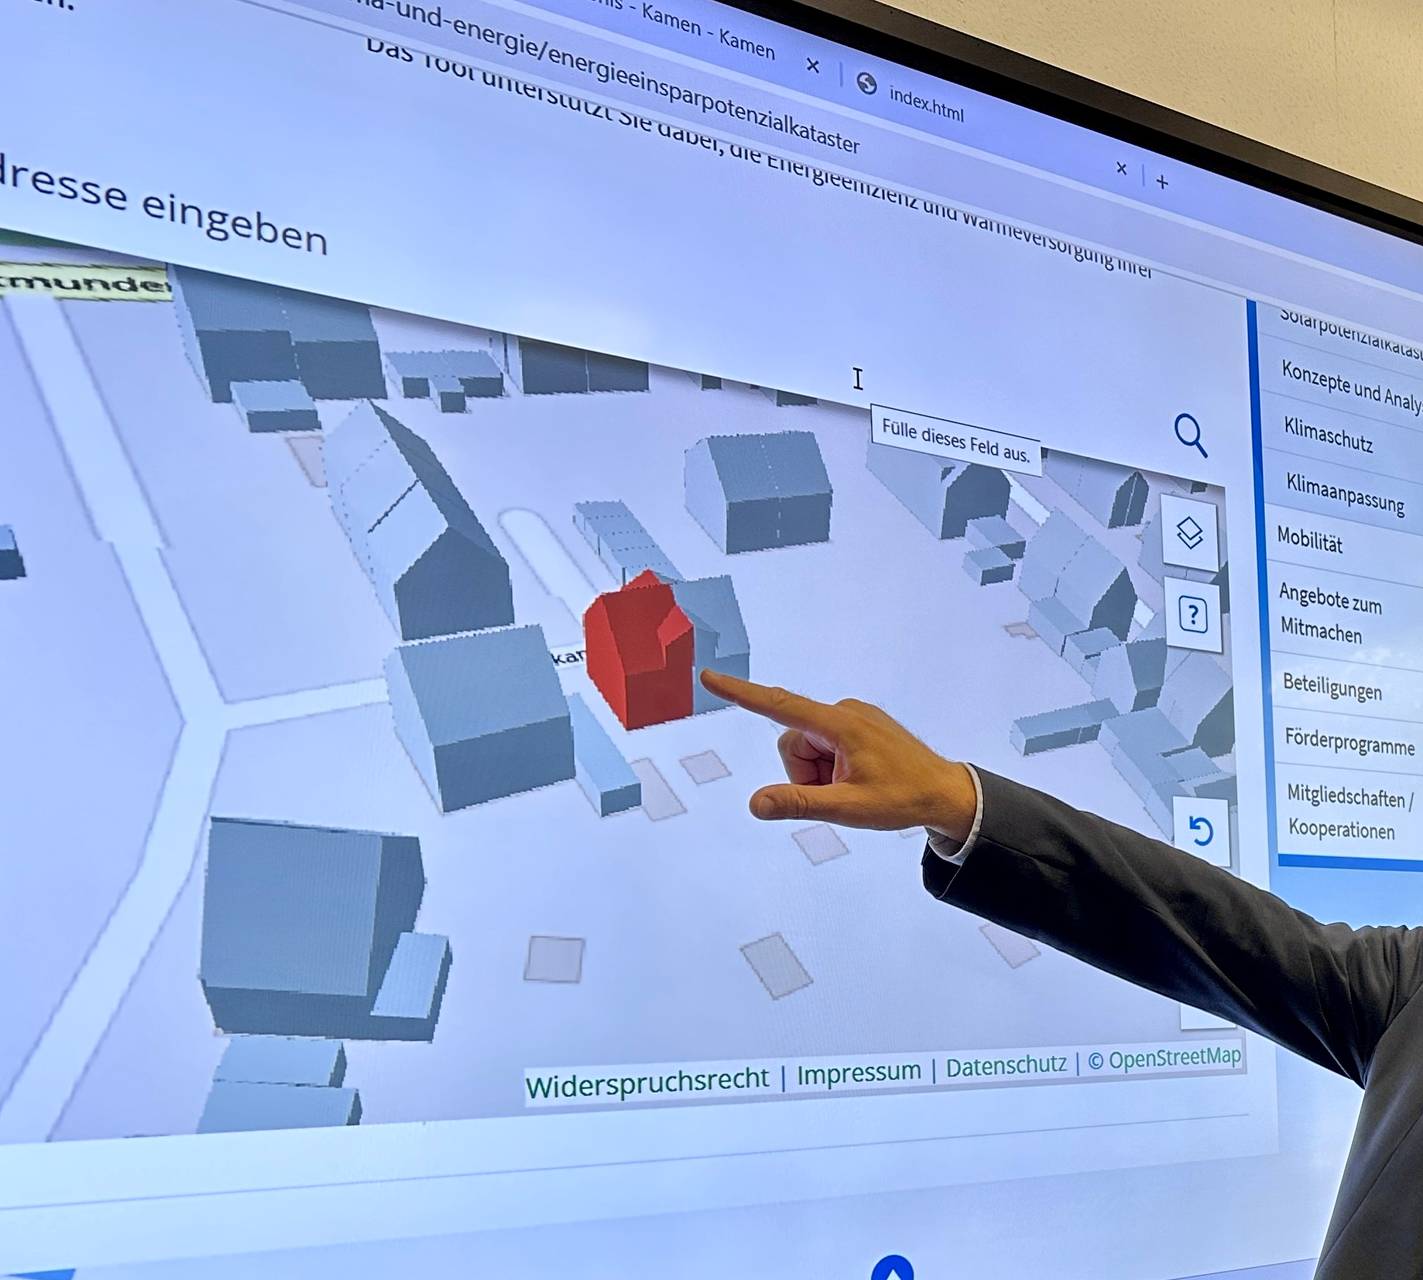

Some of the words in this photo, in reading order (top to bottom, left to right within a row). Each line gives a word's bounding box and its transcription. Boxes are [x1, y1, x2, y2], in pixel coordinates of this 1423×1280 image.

[642, 2, 701, 36] Kamen
[719, 28, 776, 60] Kamen
[889, 85, 964, 122] index.html
[0, 152, 127, 211] resse
[142, 193, 328, 256] eingeben
[0, 276, 173, 293] munde
[1281, 358, 1351, 396] Konzepte
[1354, 381, 1382, 403] und
[882, 417, 918, 439] Fülle
[921, 427, 967, 450] dieses
[970, 436, 1000, 457] Feld
[1003, 448, 1031, 463] aus.
[1284, 415, 1374, 454] Klimaschutz
[1286, 471, 1406, 519] Klimaanpassung
[1276, 524, 1344, 555] Mobilität
[1279, 581, 1350, 610] Angebote
[1352, 596, 1383, 616] zum
[1280, 616, 1363, 645] Mitmachen
[1283, 671, 1383, 704] Beteiligungen
[1284, 726, 1416, 758] Förderprogramme
[1287, 783, 1406, 811] Mitgliedschaften
[1288, 817, 1396, 841] Kooperationen
[526, 1067, 770, 1101] Widerspruchsrecht
[798, 1062, 921, 1090] Impressum
[946, 1053, 1068, 1078] Datenschutz
[1109, 1046, 1242, 1073] OpenStreetMap
